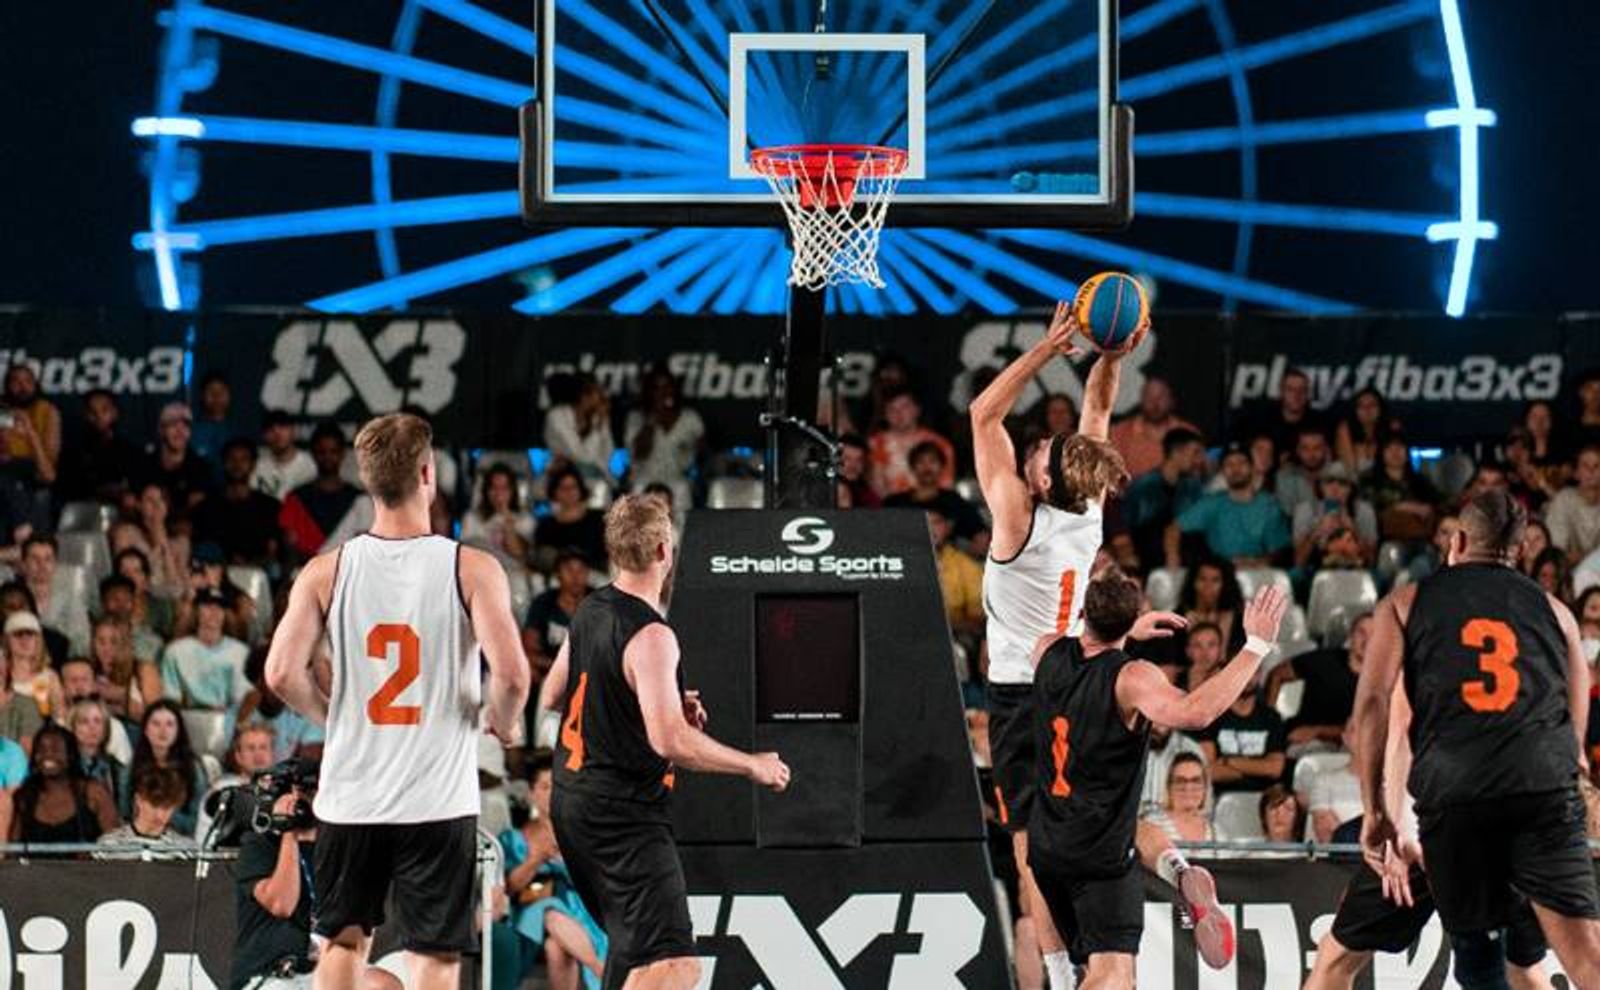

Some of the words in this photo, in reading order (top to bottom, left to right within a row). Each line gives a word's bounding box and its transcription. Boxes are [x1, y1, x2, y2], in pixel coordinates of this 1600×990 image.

[819, 555, 903, 576] Sports
[367, 624, 421, 725] 2
[1462, 618, 1519, 712] 3
[562, 671, 588, 772] 4
[1052, 716, 1071, 798] 1
